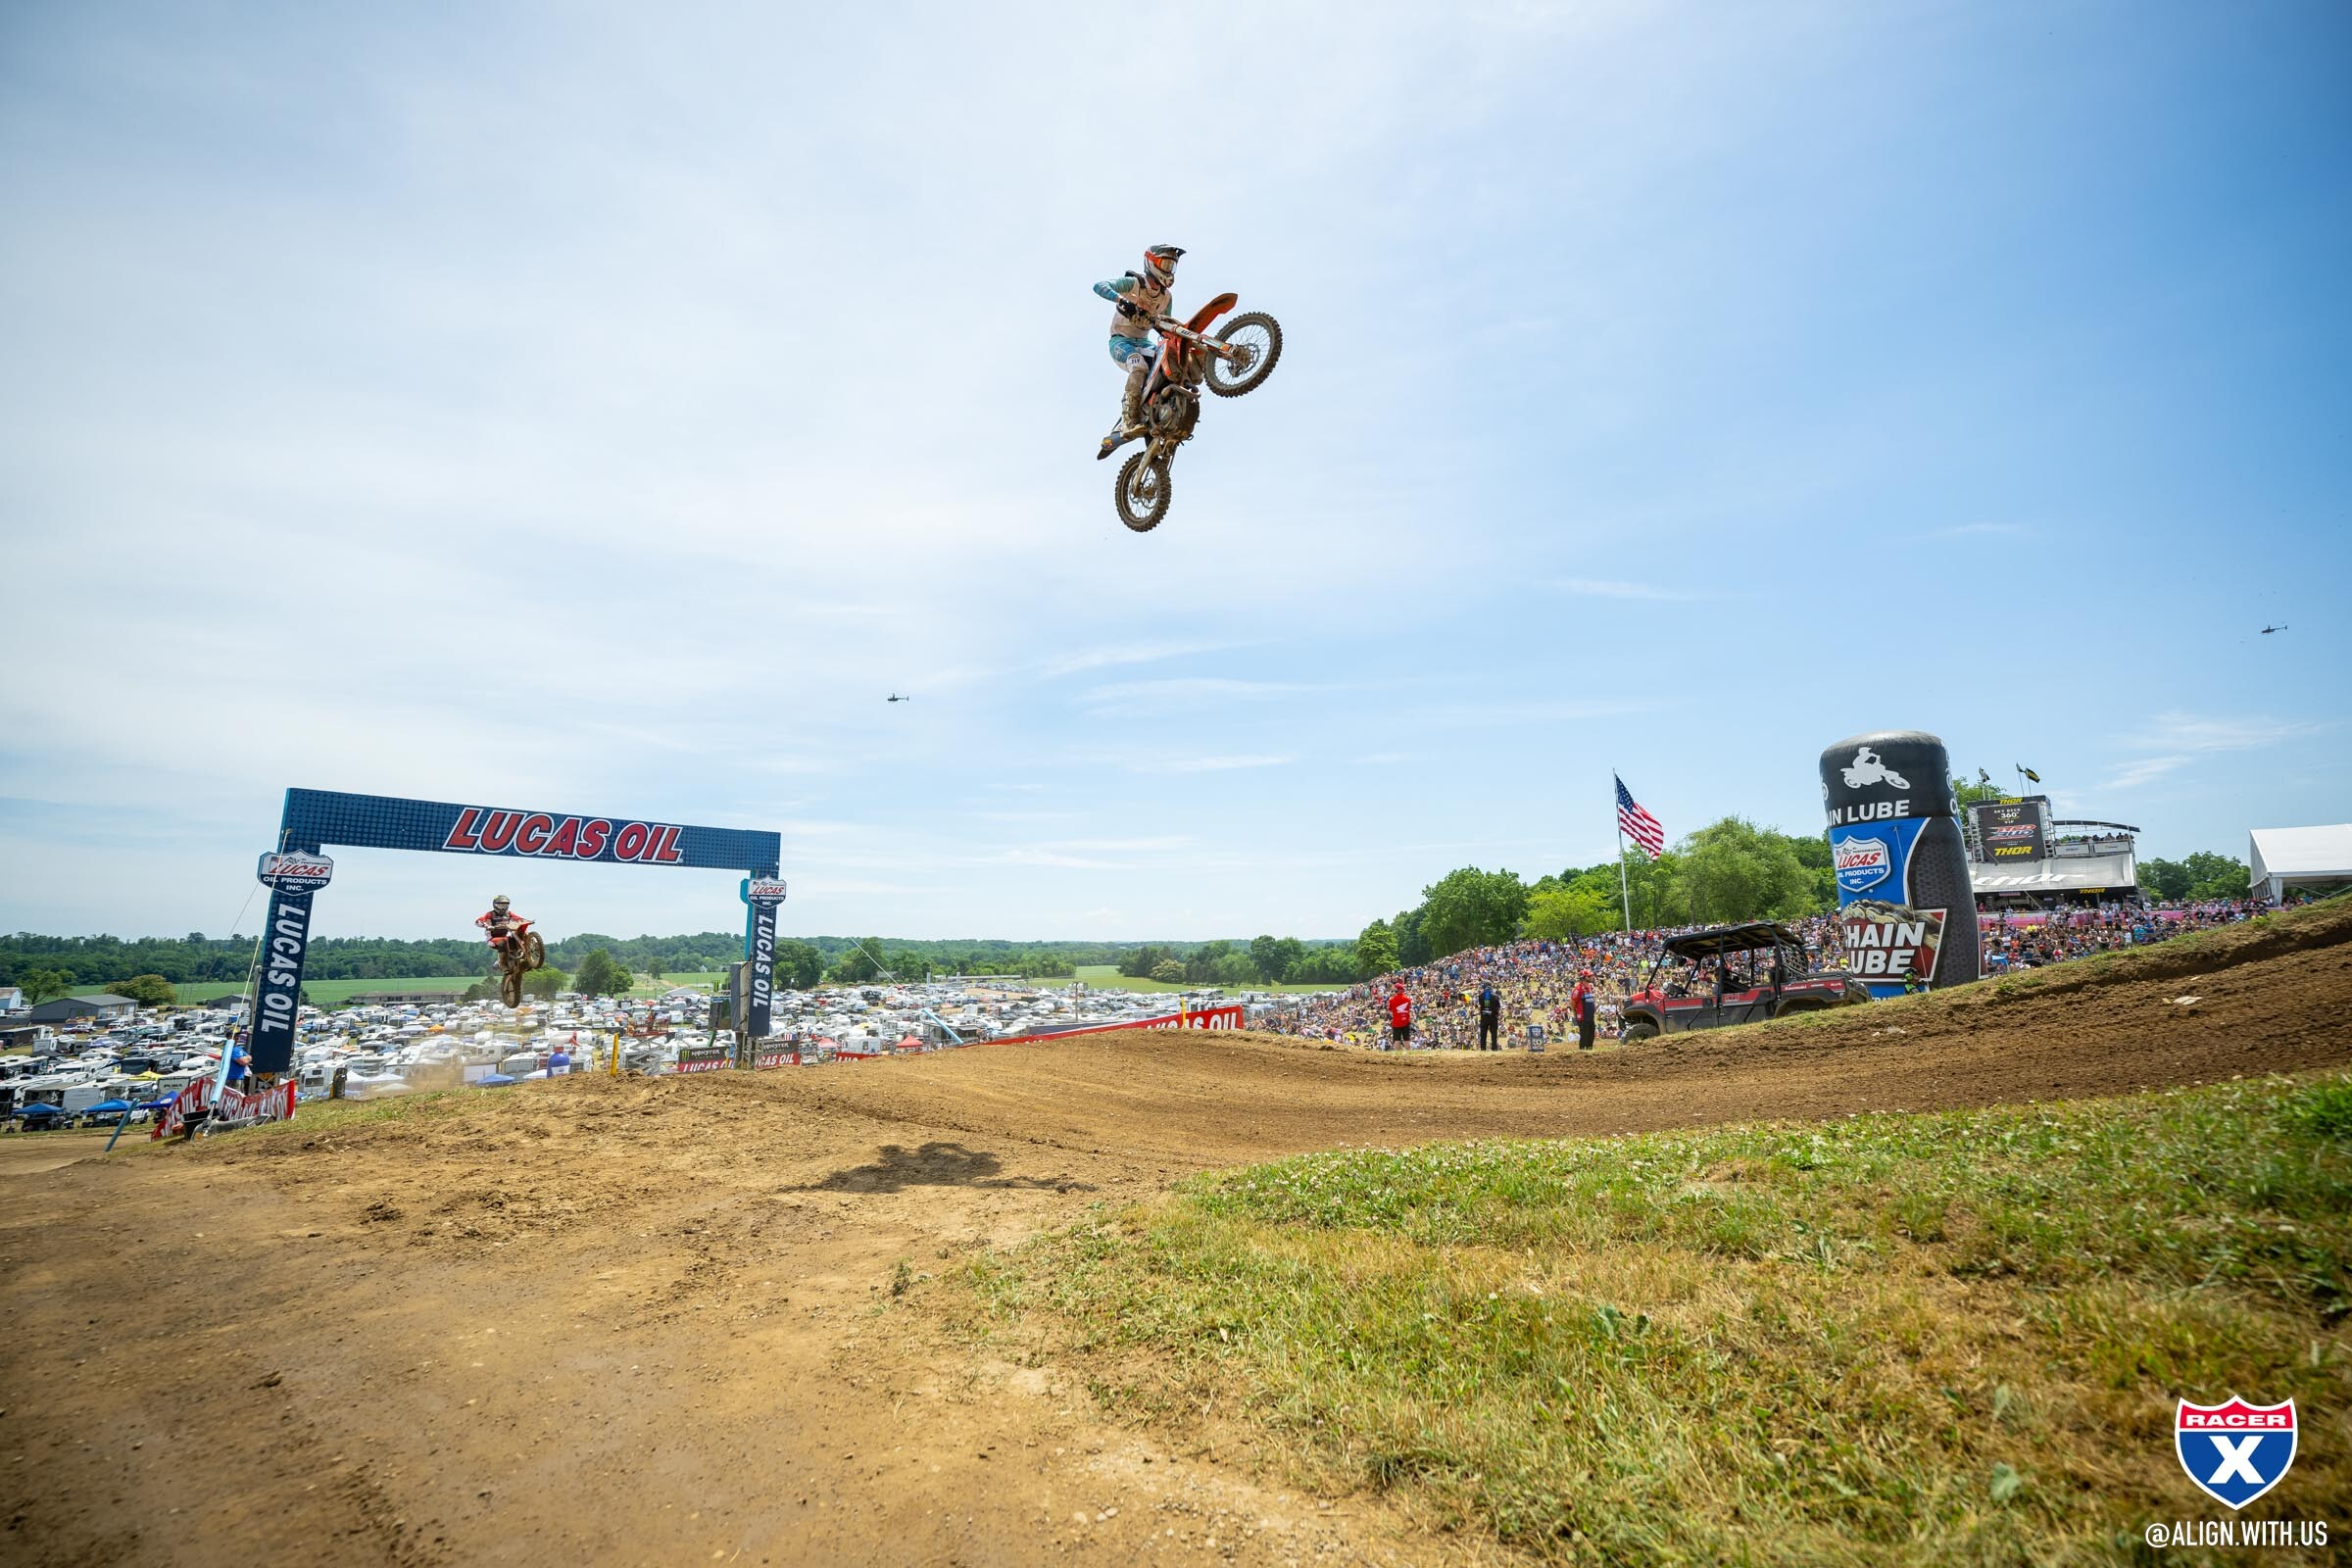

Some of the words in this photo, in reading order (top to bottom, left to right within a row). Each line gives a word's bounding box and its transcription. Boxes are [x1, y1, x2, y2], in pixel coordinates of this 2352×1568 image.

[1846, 800, 1910, 822] LUBE
[442, 807, 612, 860] LUCAS
[614, 822, 684, 864] OIL
[1838, 852, 1882, 869] LUCAS
[1994, 846, 2033, 856] THOR
[269, 863, 329, 876] LUCAS
[280, 876, 327, 885] PRODUCTS
[1844, 867, 1885, 878] PRODUCTS
[268, 903, 307, 988] LUCAS
[755, 914, 773, 975] LUCAS
[1845, 922, 1926, 948] HAIN
[1850, 950, 1915, 974] UBE
[753, 978, 770, 1007] OIL
[261, 993, 294, 1033] OIL
[755, 1054, 777, 1067] UCAS
[779, 1054, 794, 1064] OIL
